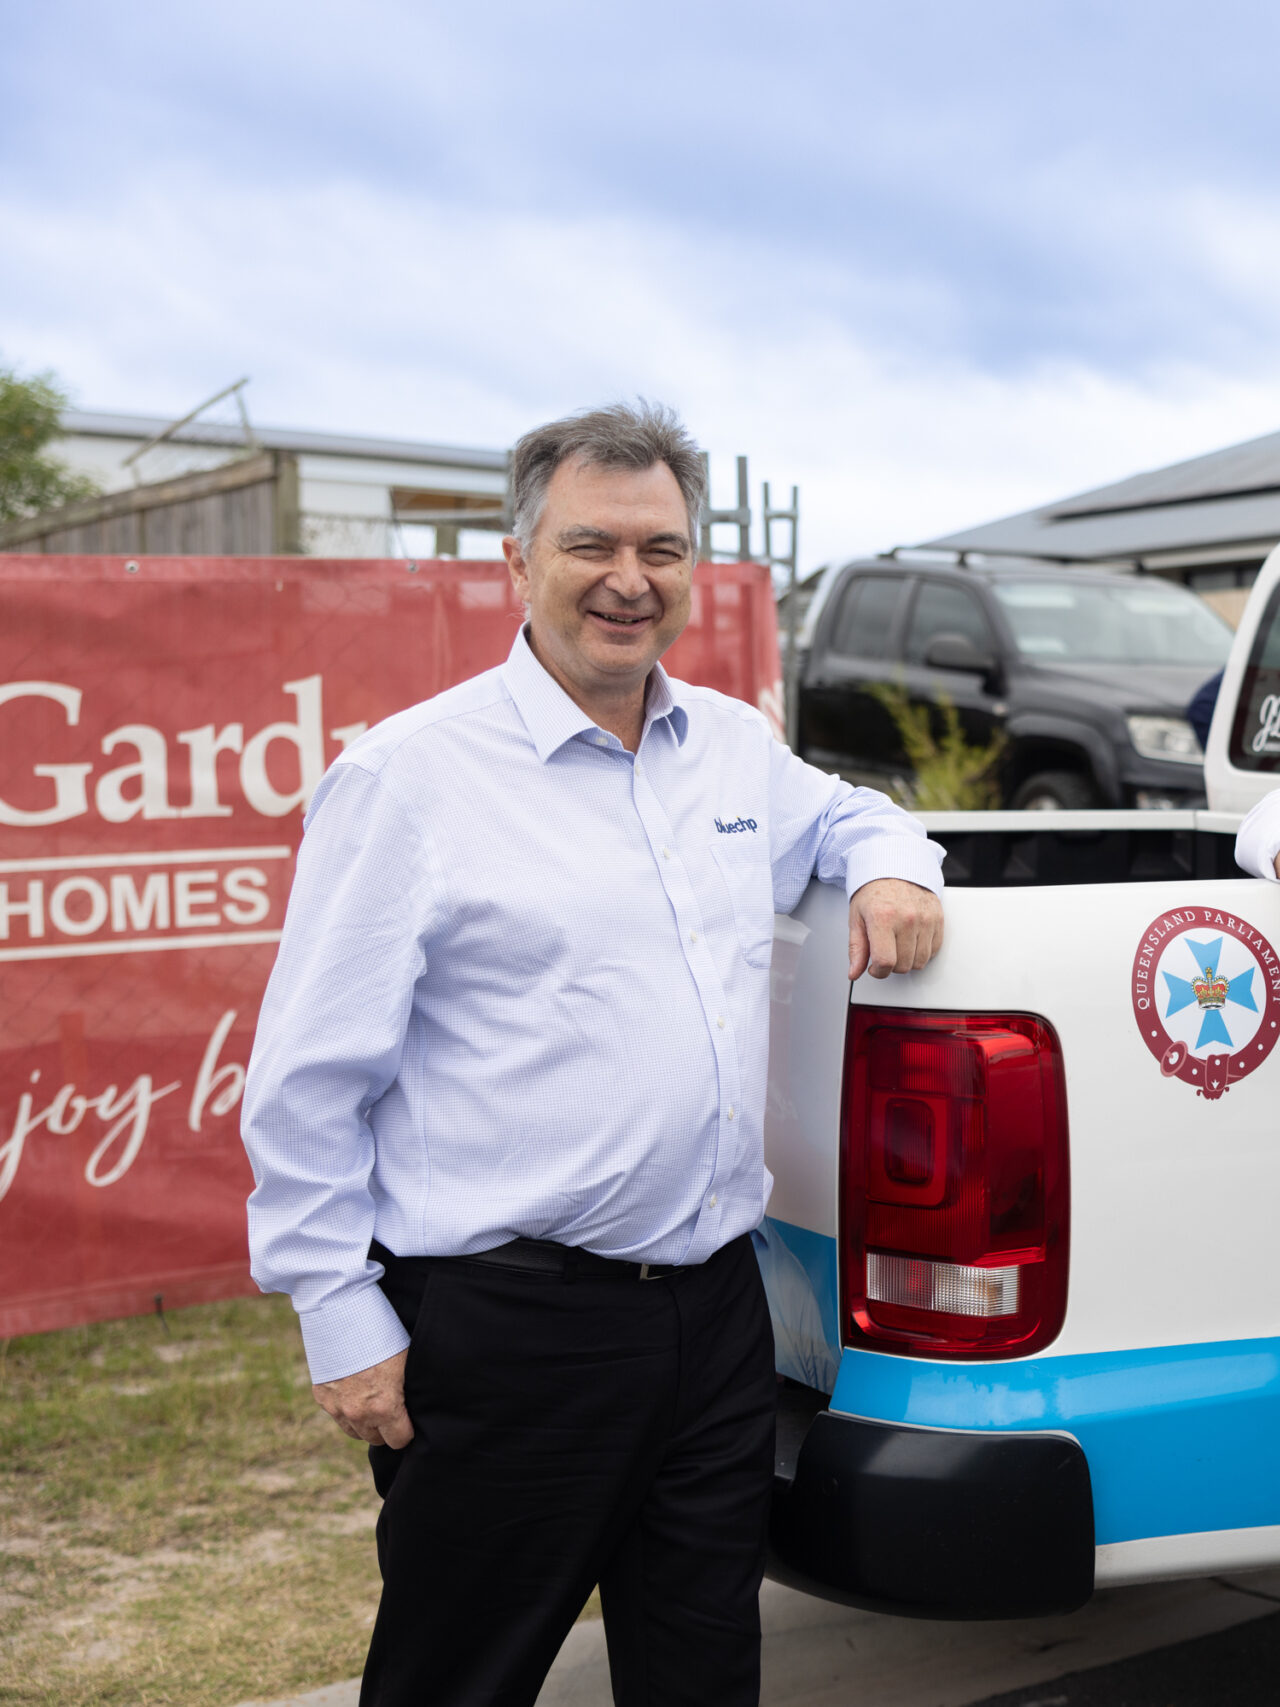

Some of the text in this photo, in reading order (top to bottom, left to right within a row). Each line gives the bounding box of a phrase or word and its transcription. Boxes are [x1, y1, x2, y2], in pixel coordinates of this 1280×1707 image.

[0, 674, 368, 827] Gard
[0, 867, 270, 939] HOMES
[1136, 910, 1197, 1011] QUEENSLAND
